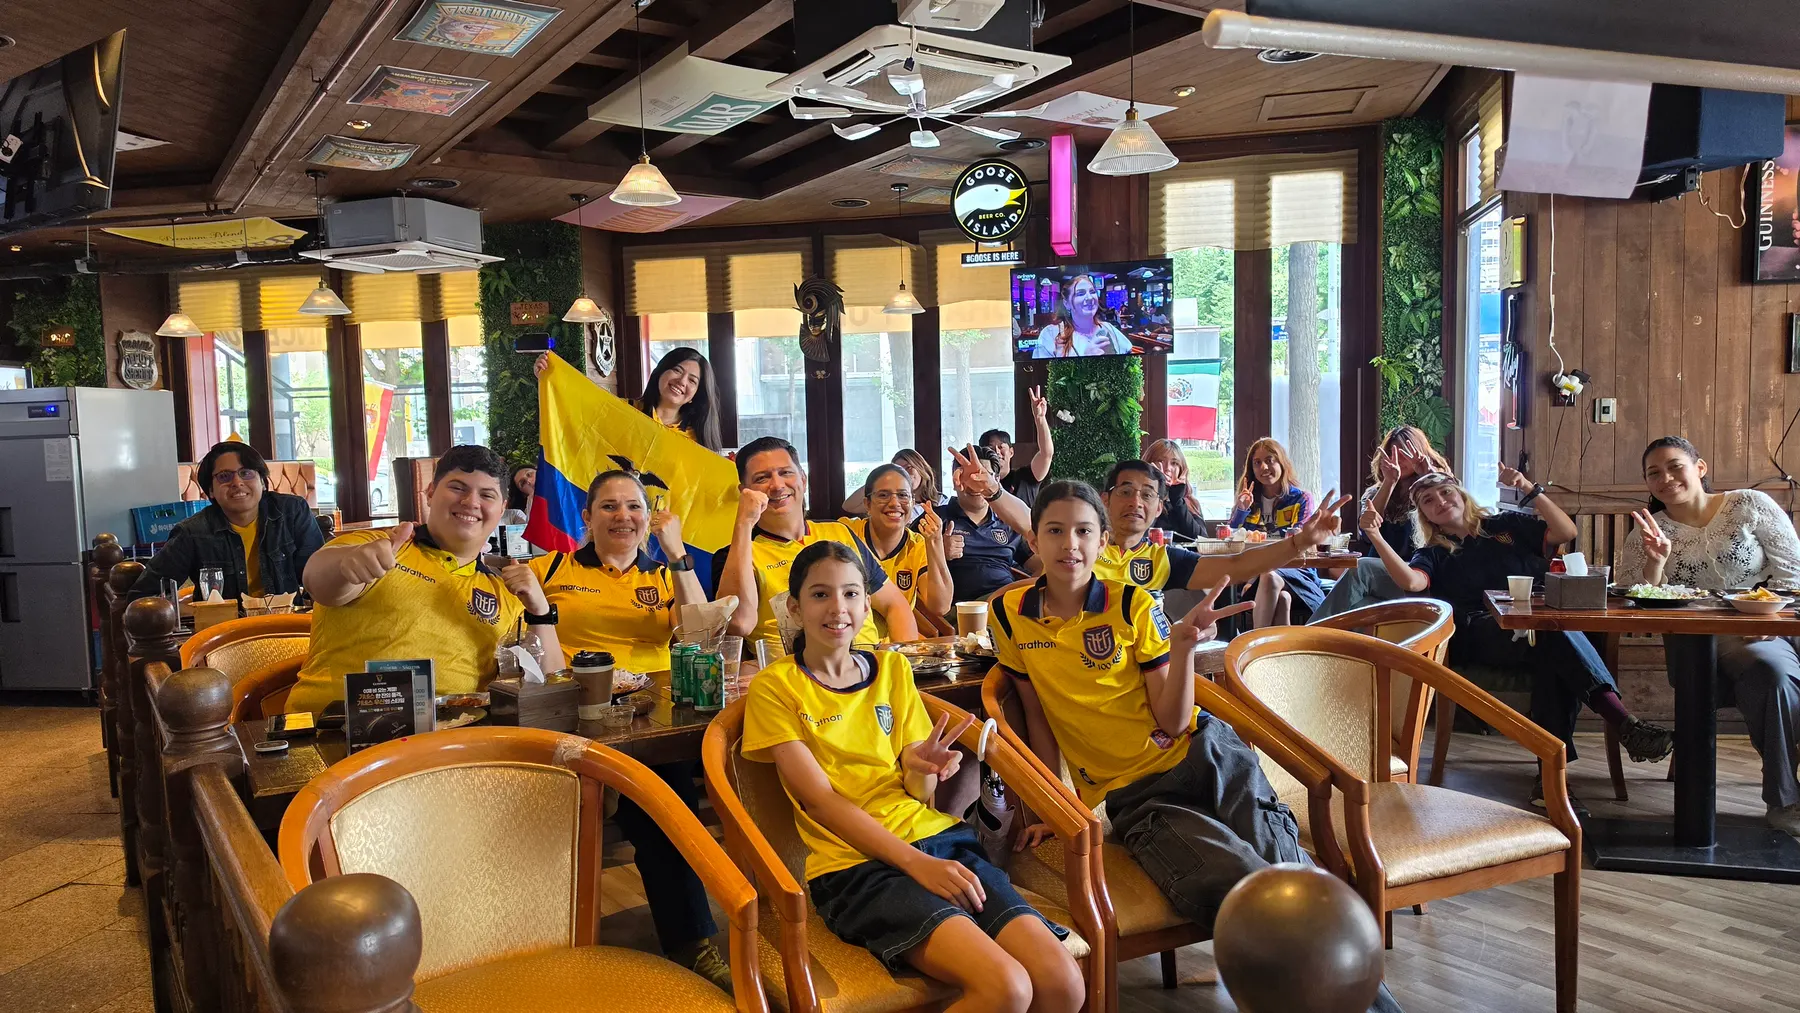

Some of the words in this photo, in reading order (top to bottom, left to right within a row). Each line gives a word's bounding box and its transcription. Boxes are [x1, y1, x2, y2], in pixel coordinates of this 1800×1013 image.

[441, 5, 491, 18] GREAT
[491, 9, 543, 27] WHITE
[965, 166, 1016, 187] GOOSE
[1759, 160, 1775, 251] GUINNESS
[966, 212, 1019, 236] ISLAND
[966, 253, 992, 263] #GOOSE
[993, 252, 1000, 261] IS
[1001, 251, 1020, 261] HERE
[560, 584, 601, 594] marathon
[1018, 640, 1057, 651] arathon
[1097, 662, 1112, 671] 100
